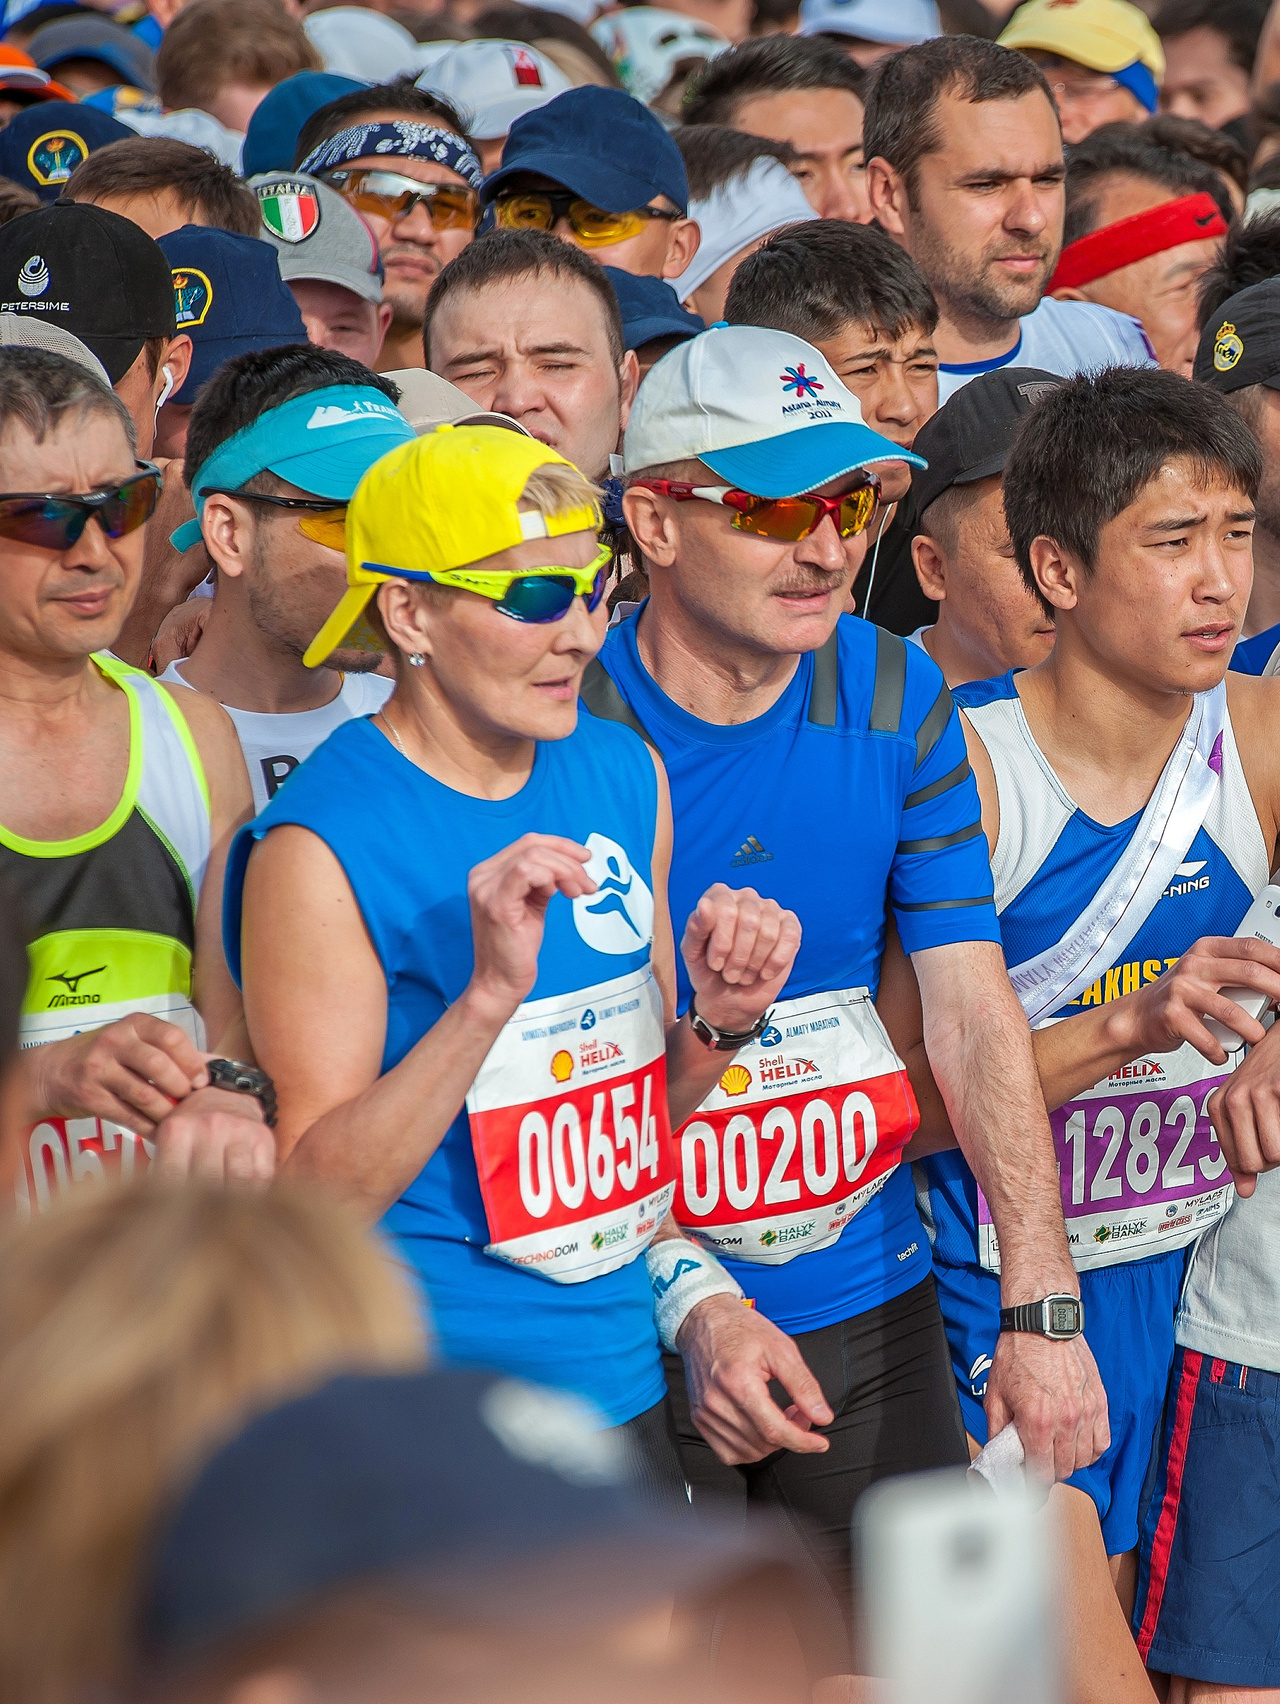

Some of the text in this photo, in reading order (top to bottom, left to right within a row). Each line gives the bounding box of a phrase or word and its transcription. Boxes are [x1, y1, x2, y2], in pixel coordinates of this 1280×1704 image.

[257, 182, 315, 197] ITALIA
[1, 301, 70, 311] PETERSIME
[808, 410, 833, 419] 2011
[730, 853, 774, 868] adidas
[1066, 957, 1180, 1006] AKHS
[785, 1016, 841, 1039] ALMATY MARATHON
[579, 1039, 598, 1053] Shell
[580, 1043, 623, 1068] HELIX
[759, 1054, 784, 1069] Shell
[759, 1059, 819, 1083] HELIX
[762, 1079, 799, 1091] Моторные
[1108, 1078, 1143, 1088] Моторные
[518, 1075, 660, 1219] 00654
[681, 1091, 878, 1217] 00200
[1184, 1188, 1224, 1210] MYLAPS
[604, 1222, 629, 1236] HALYK
[778, 1221, 816, 1236] HALYK
[1111, 1228, 1143, 1239] BANK
[1112, 1220, 1148, 1232] HALYK
[604, 1232, 628, 1246] BANK
[778, 1229, 812, 1243] BANK
[511, 1242, 579, 1265] TECHNODOM
[896, 1242, 920, 1262] techfit
